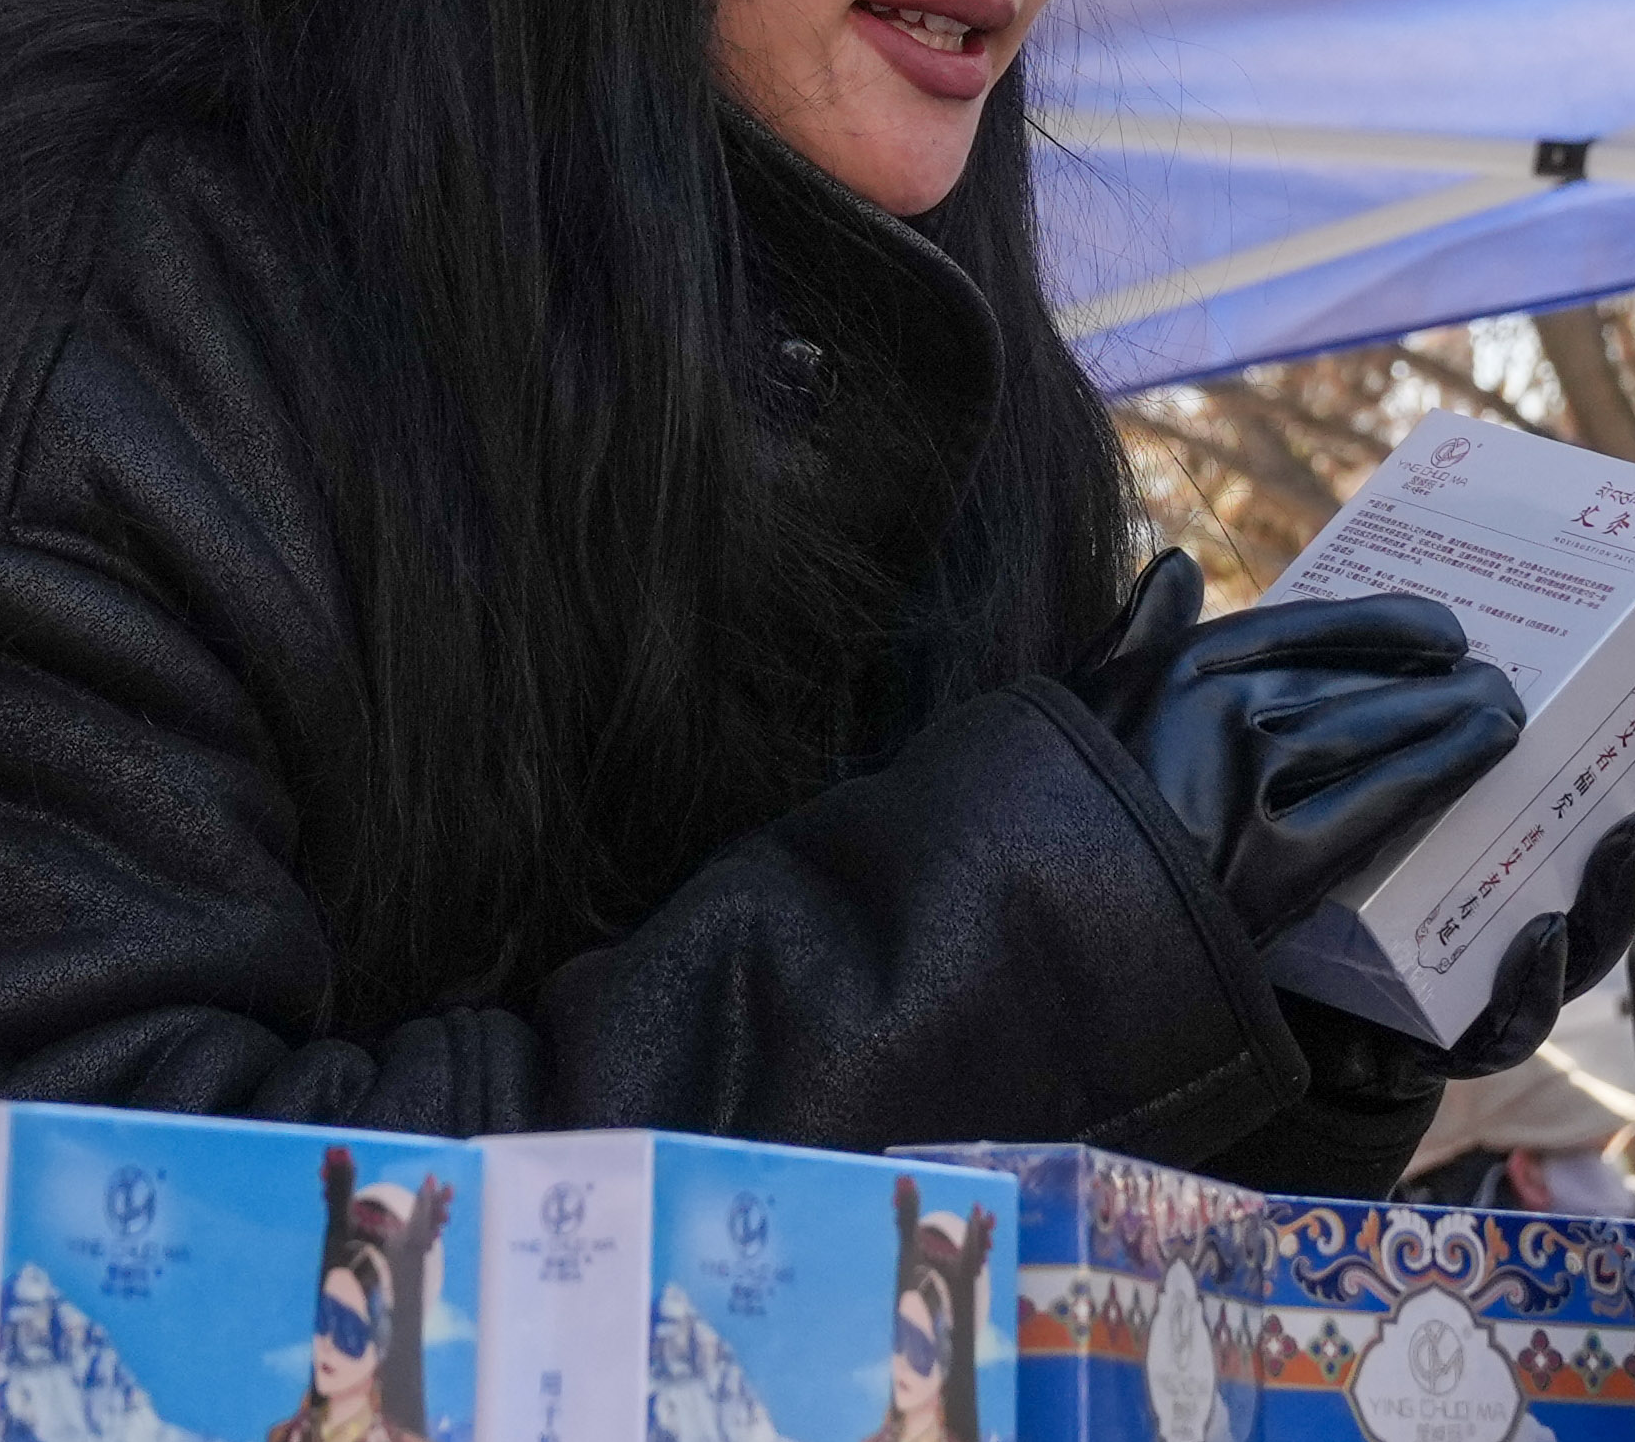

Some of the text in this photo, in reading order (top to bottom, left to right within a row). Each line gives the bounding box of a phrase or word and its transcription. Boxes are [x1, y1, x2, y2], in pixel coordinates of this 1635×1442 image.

[1435, 823, 1546, 947] 善艾者寿延
